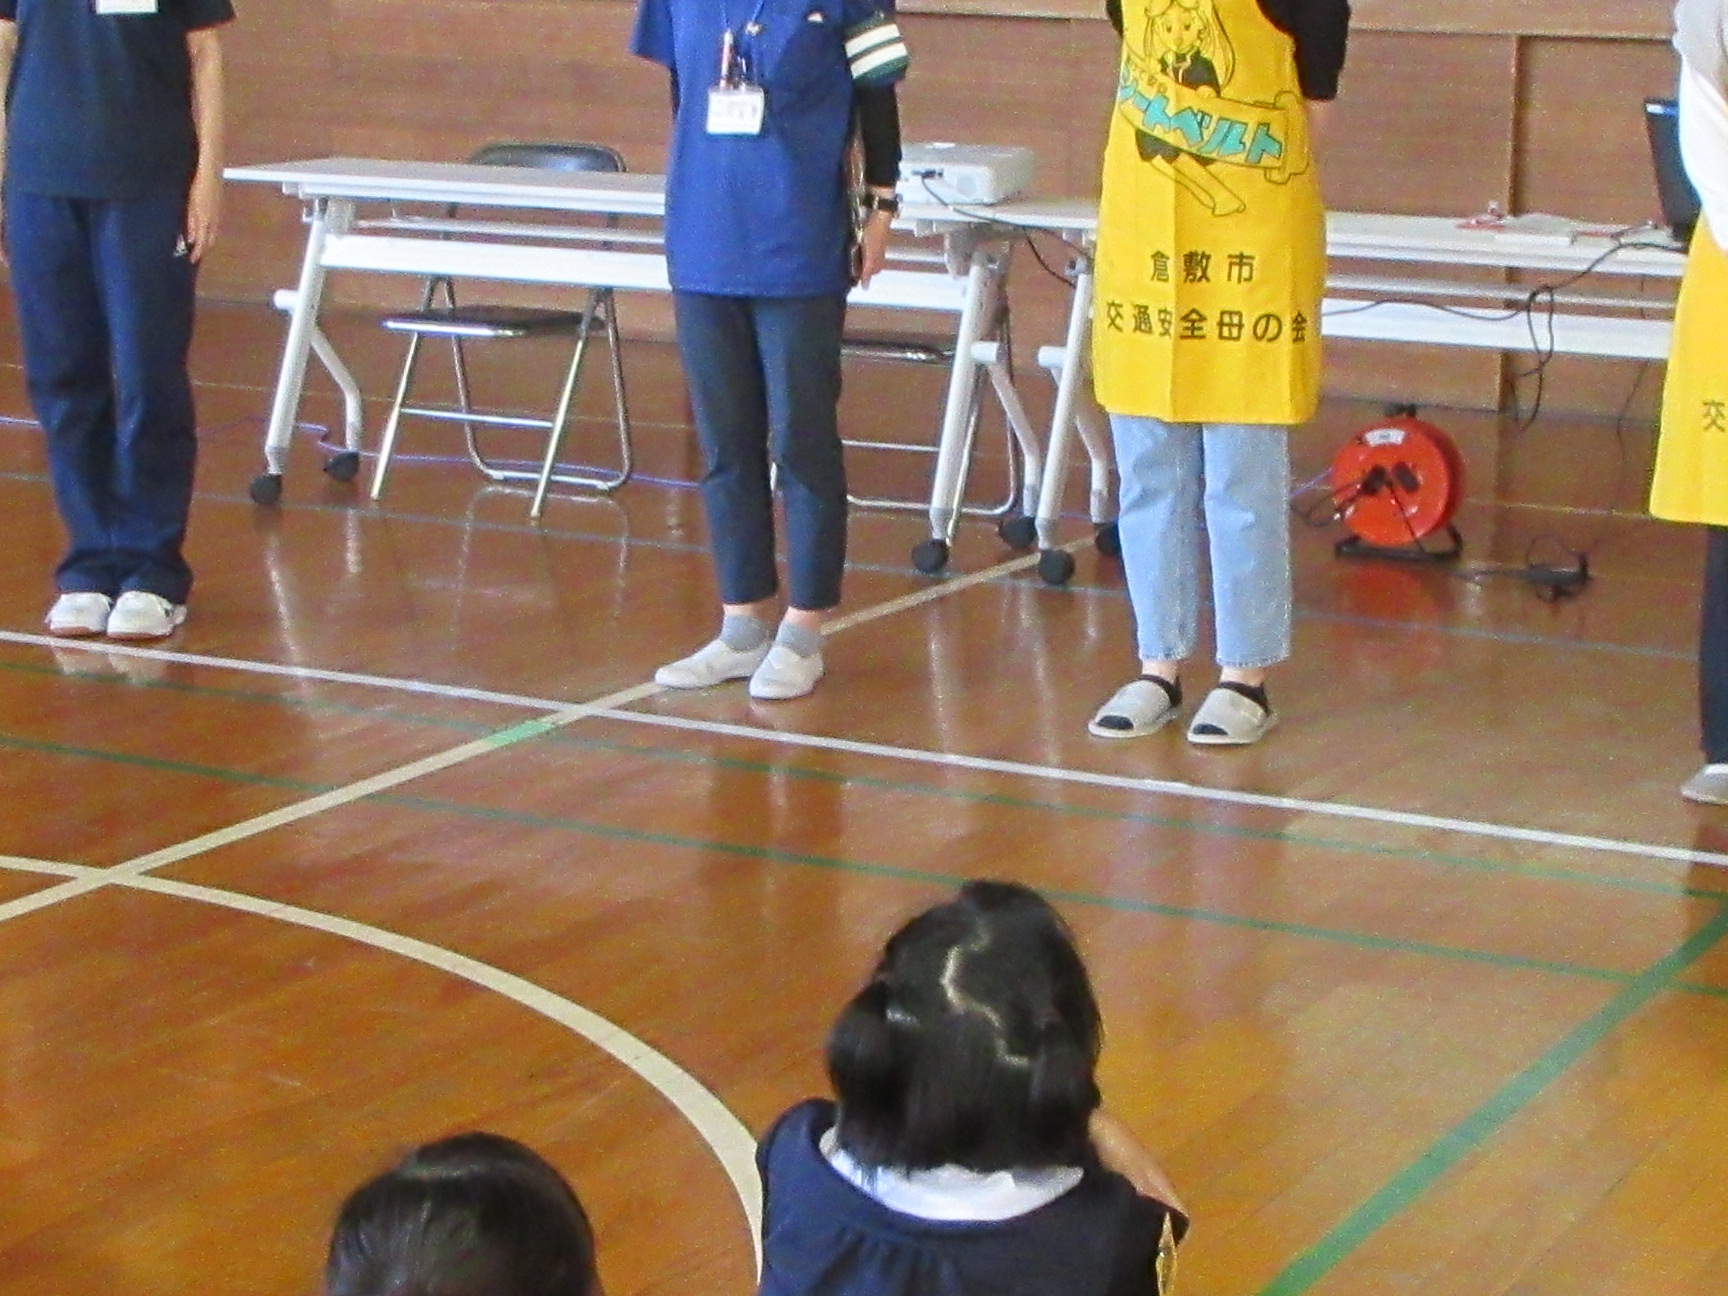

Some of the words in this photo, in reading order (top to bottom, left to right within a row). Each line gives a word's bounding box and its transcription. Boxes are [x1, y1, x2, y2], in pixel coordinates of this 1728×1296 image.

[1150, 250, 1257, 284] 倉敷市
[1106, 300, 1308, 345] 交通安全母の会
